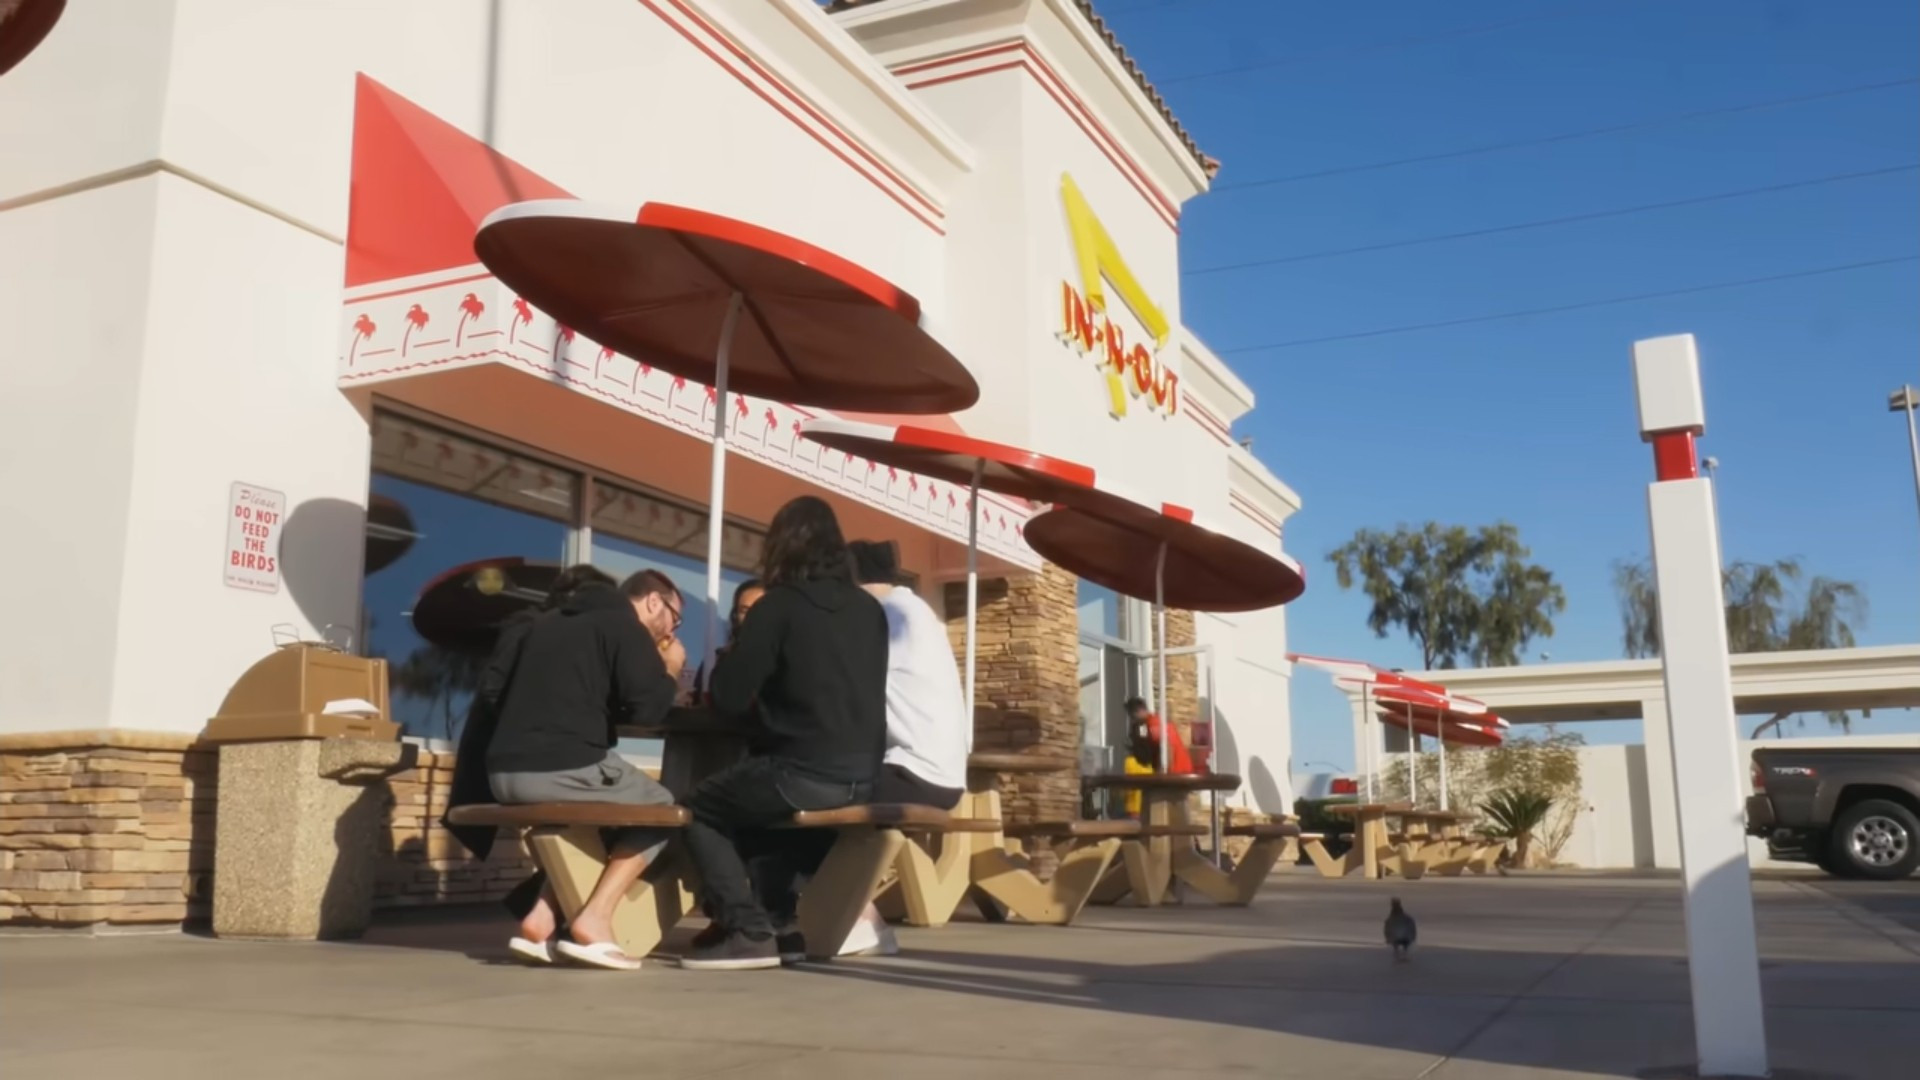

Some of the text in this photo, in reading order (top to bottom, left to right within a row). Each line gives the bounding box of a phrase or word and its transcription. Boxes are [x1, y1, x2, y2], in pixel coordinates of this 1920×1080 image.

[1062, 280, 1178, 416] IN-N-OUT
[235, 505, 279, 525] DO NOT
[242, 522, 269, 538] FEED
[244, 537, 266, 553] THE
[231, 550, 275, 573] BIRDS
